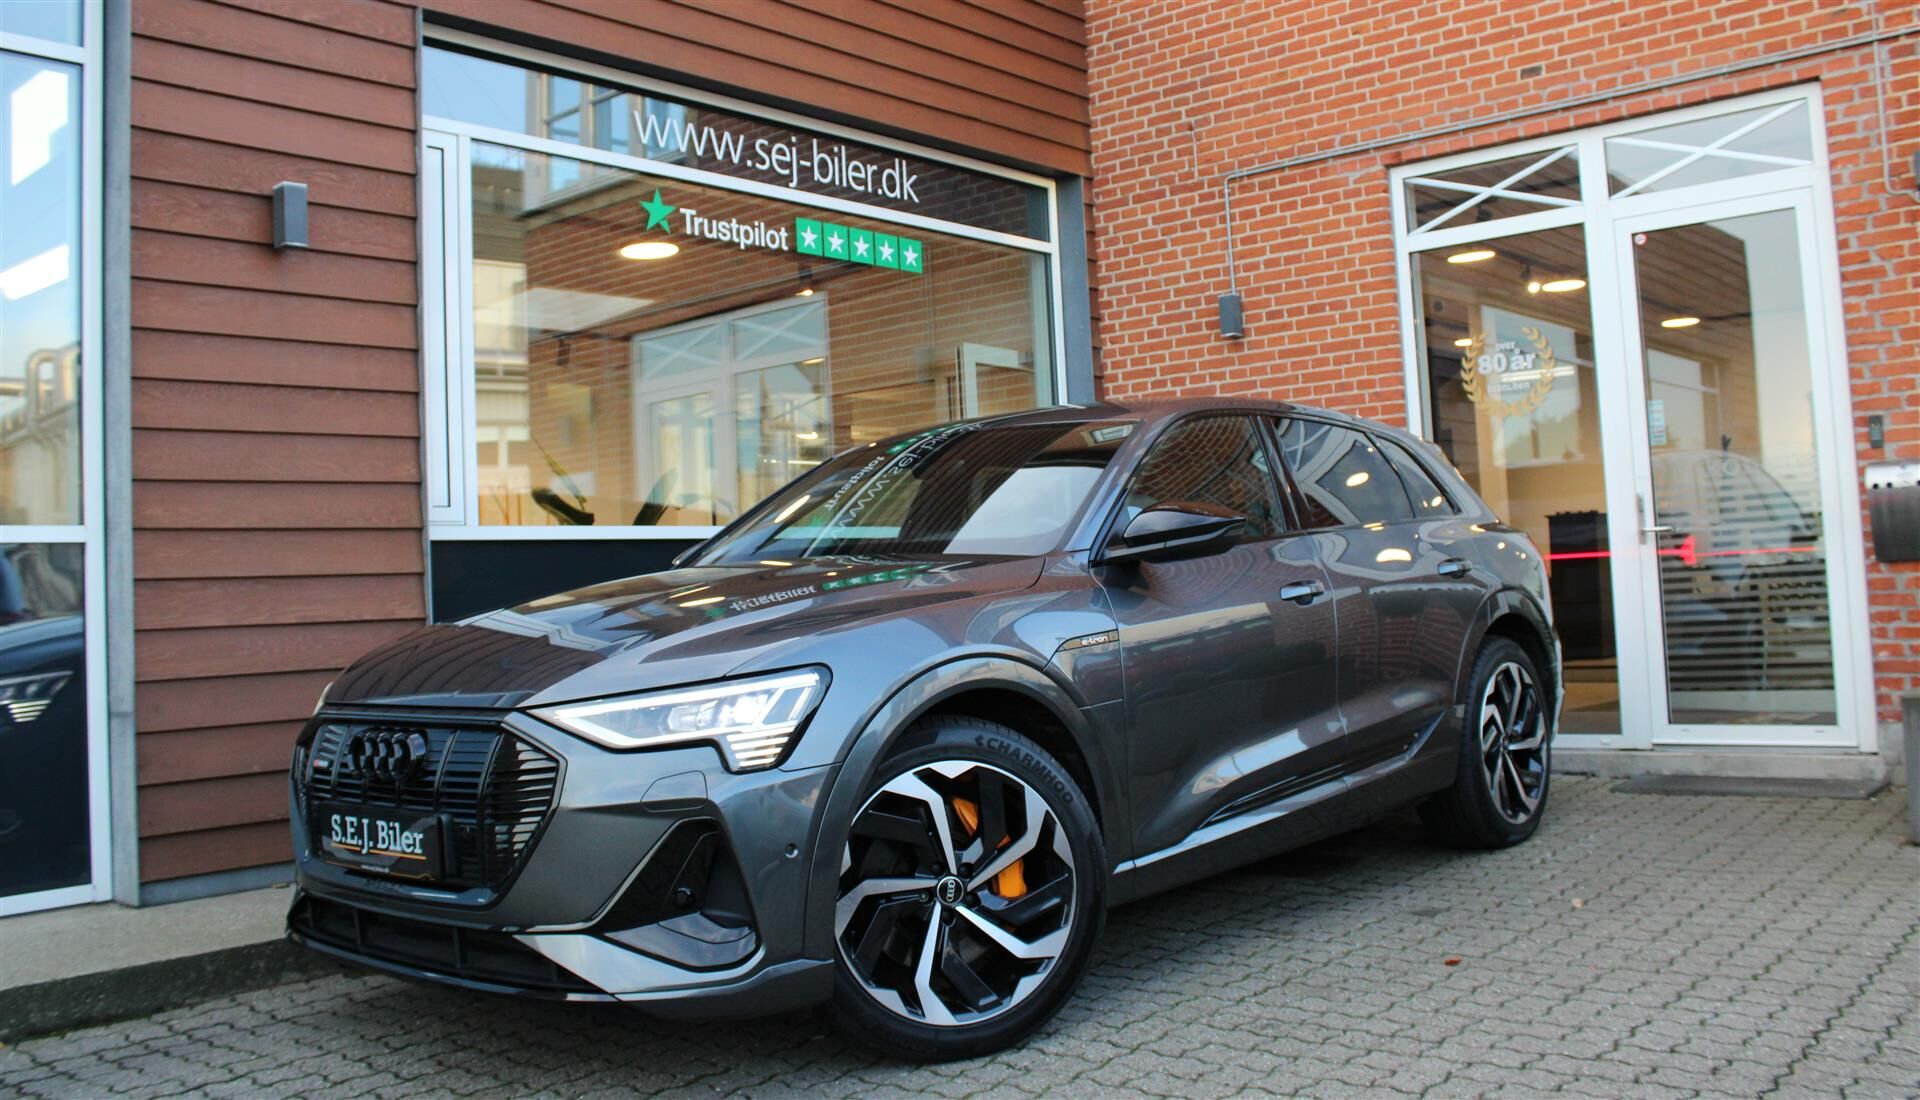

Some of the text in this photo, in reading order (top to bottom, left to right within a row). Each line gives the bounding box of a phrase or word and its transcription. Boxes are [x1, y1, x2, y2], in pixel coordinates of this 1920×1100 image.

[633, 110, 920, 203] www.sej-biler.dk
[679, 207, 788, 251] Trustpilot
[1478, 348, 1536, 375] 80 år
[1495, 341, 1516, 352] over
[1081, 635, 1108, 646] e-tron
[330, 813, 424, 855] S.E.J. Biler
